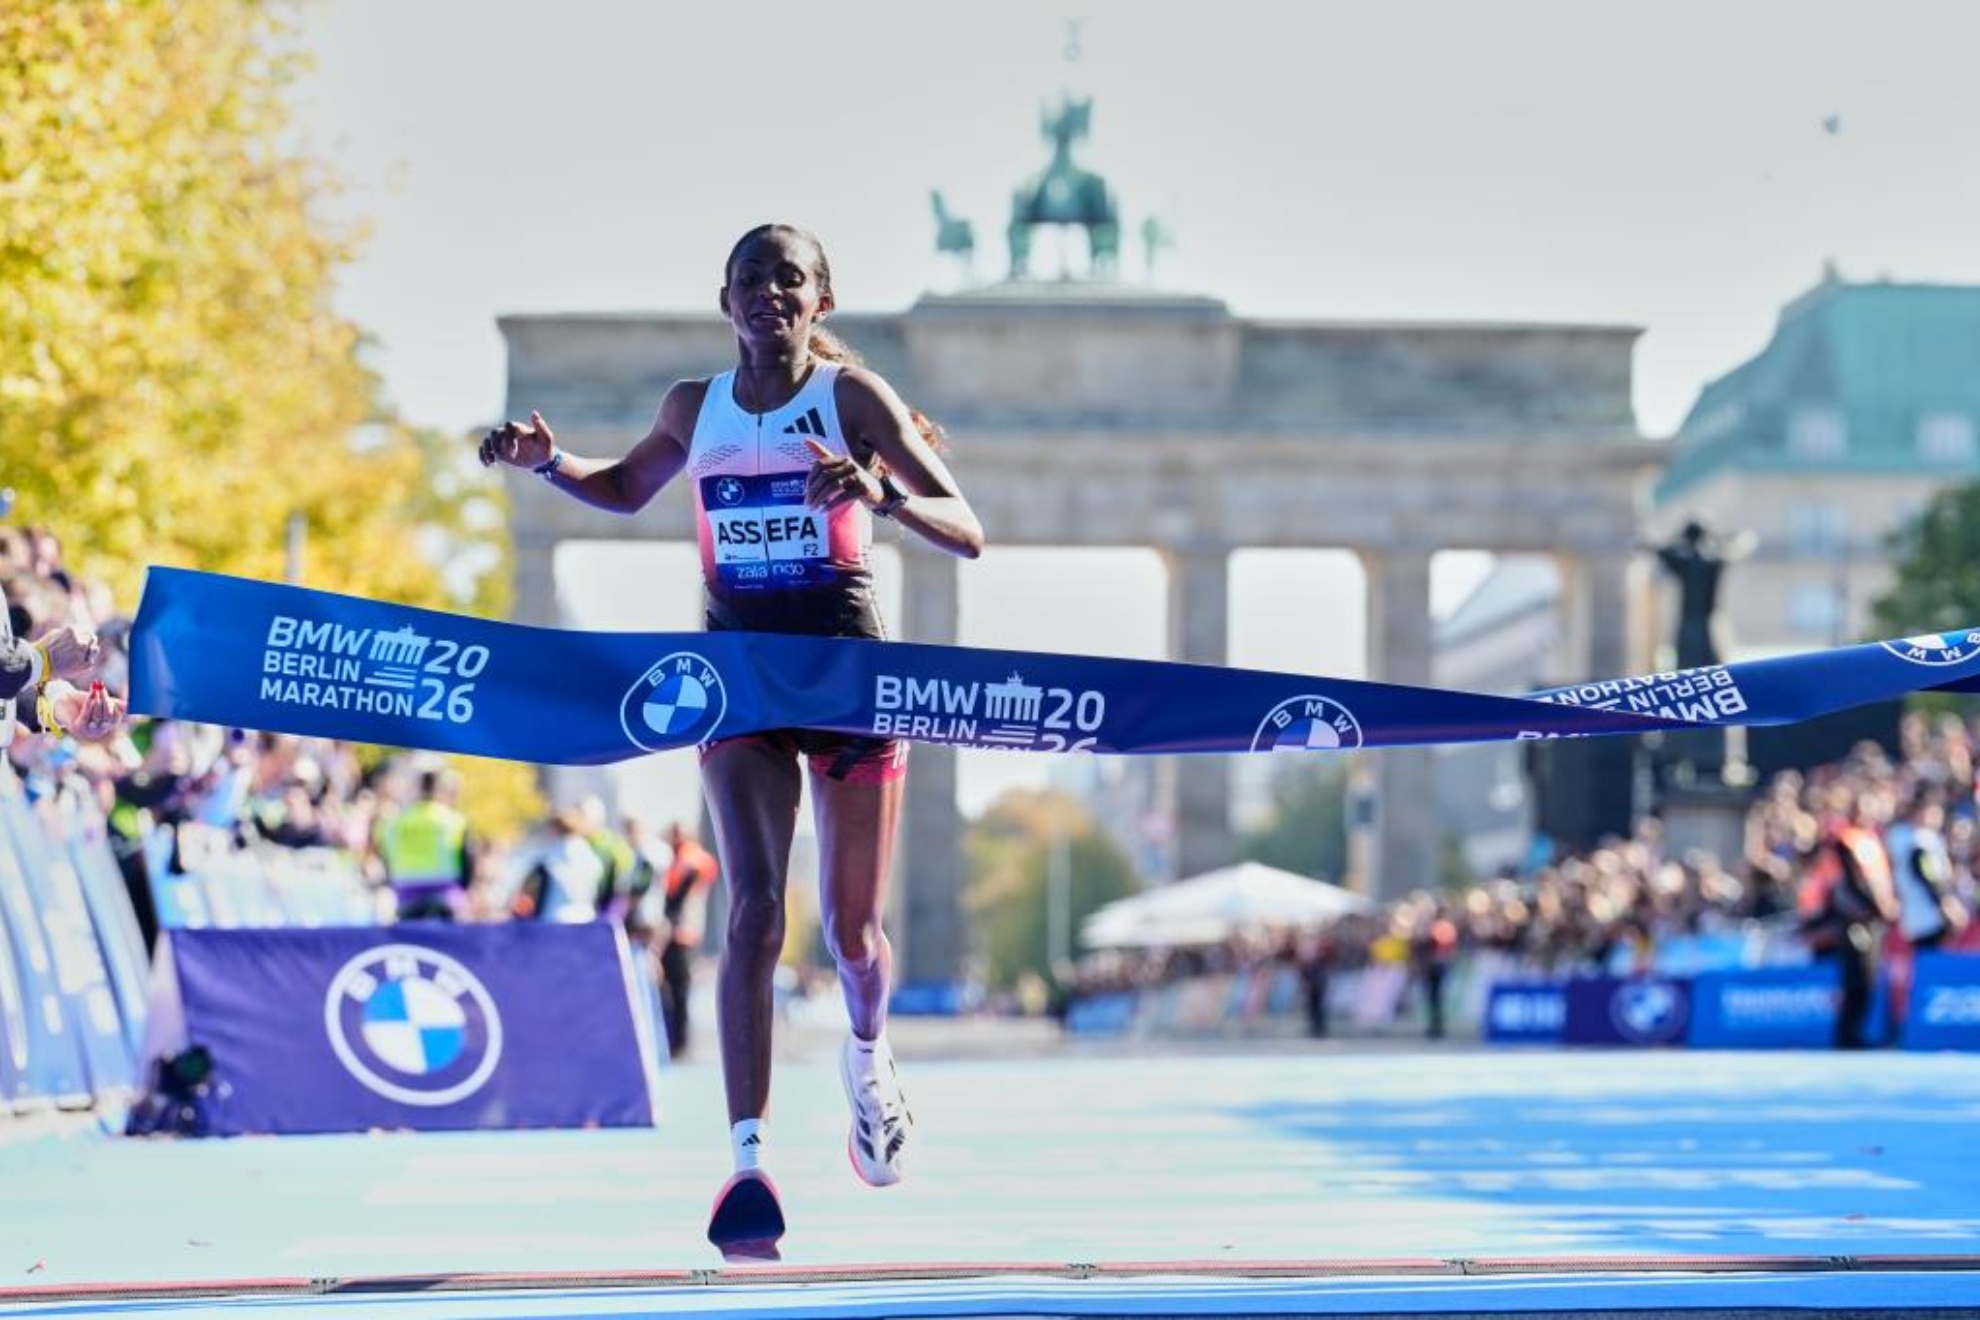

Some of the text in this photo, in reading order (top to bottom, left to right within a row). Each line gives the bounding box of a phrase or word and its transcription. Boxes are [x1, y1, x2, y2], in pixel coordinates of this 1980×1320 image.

[718, 517, 818, 545] ASSEFA
[803, 543, 818, 556] F2
[267, 615, 490, 678] BMW 20
[263, 650, 361, 682] BERLIN
[648, 657, 716, 688] BMW
[260, 677, 476, 723] MARATHON 26
[875, 674, 1105, 731] BMW 20
[1625, 669, 1734, 711] BERLIN
[873, 713, 977, 740] BERLIN
[1272, 701, 1353, 734] BMW
